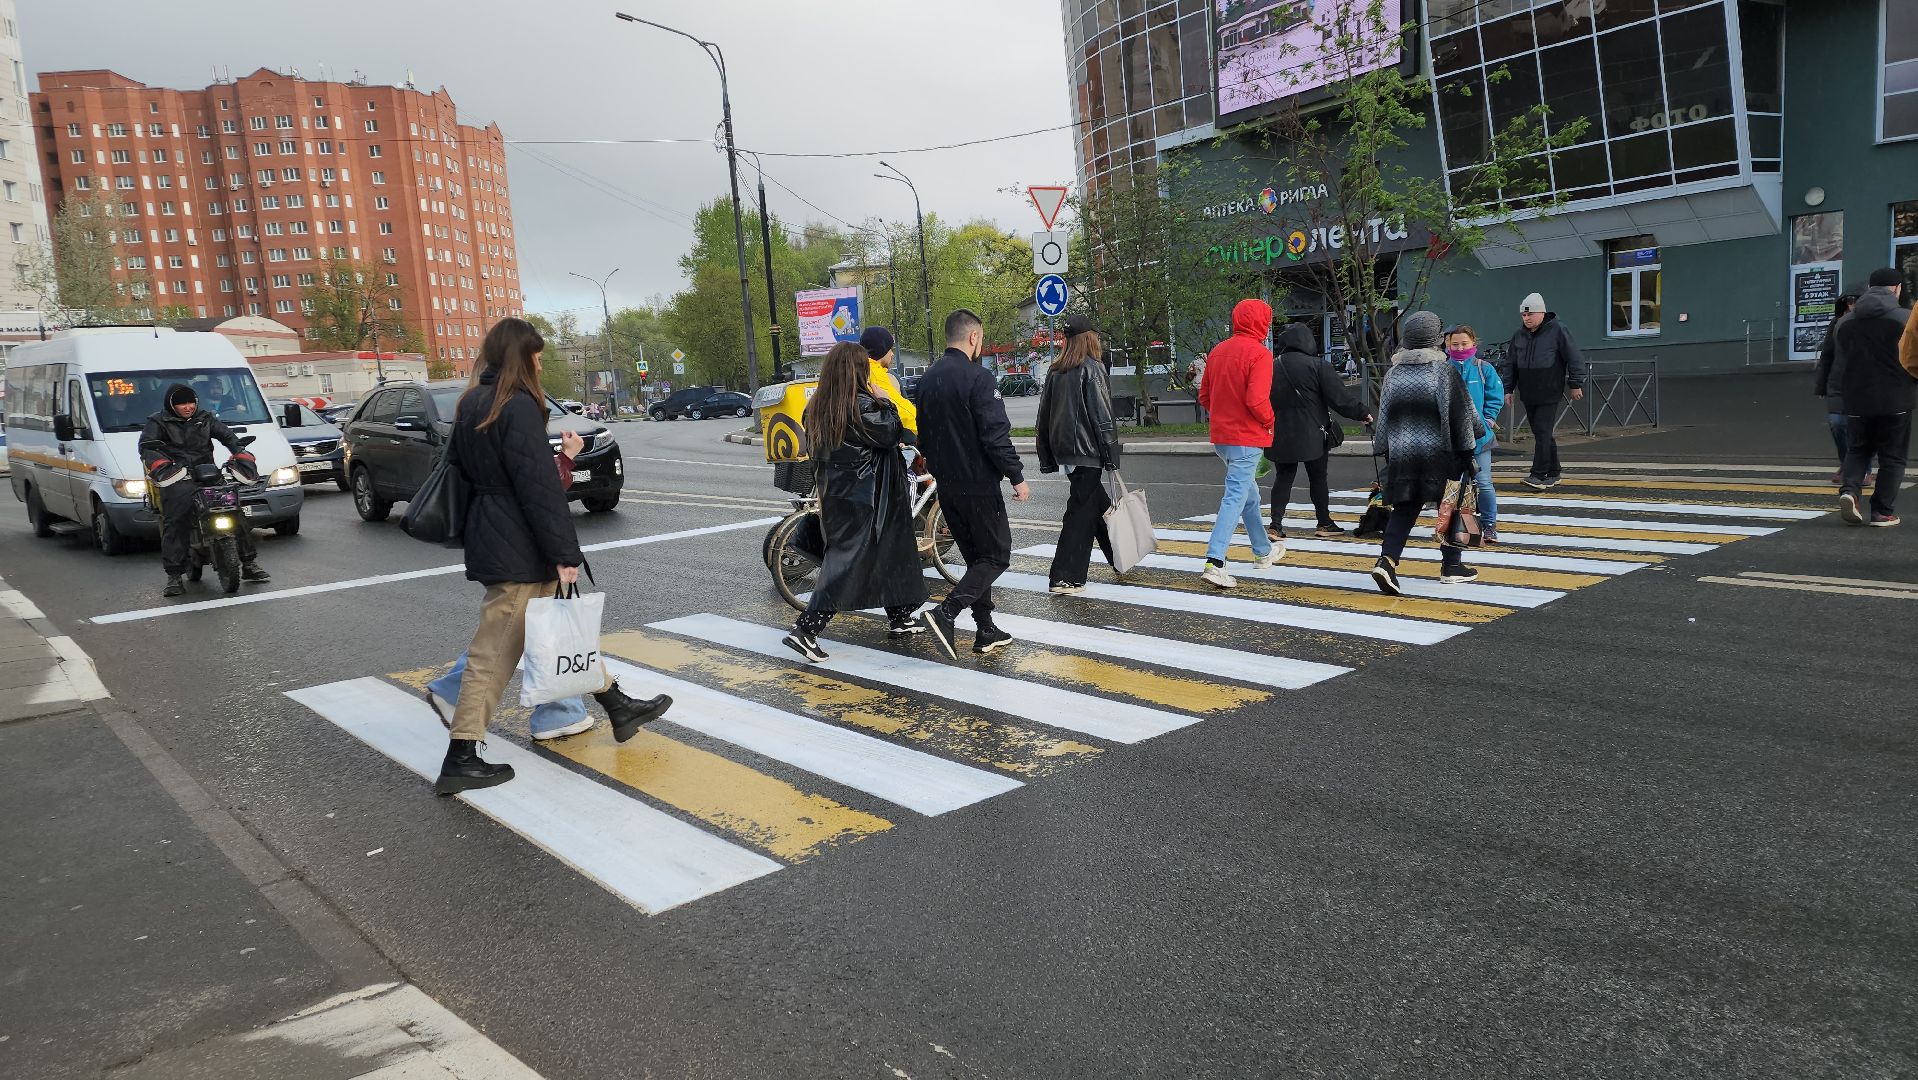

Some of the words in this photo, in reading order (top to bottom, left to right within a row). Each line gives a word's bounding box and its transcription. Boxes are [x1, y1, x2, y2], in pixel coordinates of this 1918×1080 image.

[1629, 103, 1708, 131] ФОТО
[1203, 198, 1255, 219] АПТЕКА
[1280, 183, 1330, 206] РИГЛА
[1810, 291, 1829, 299] ЭТАЖ
[556, 651, 597, 676] D&F
